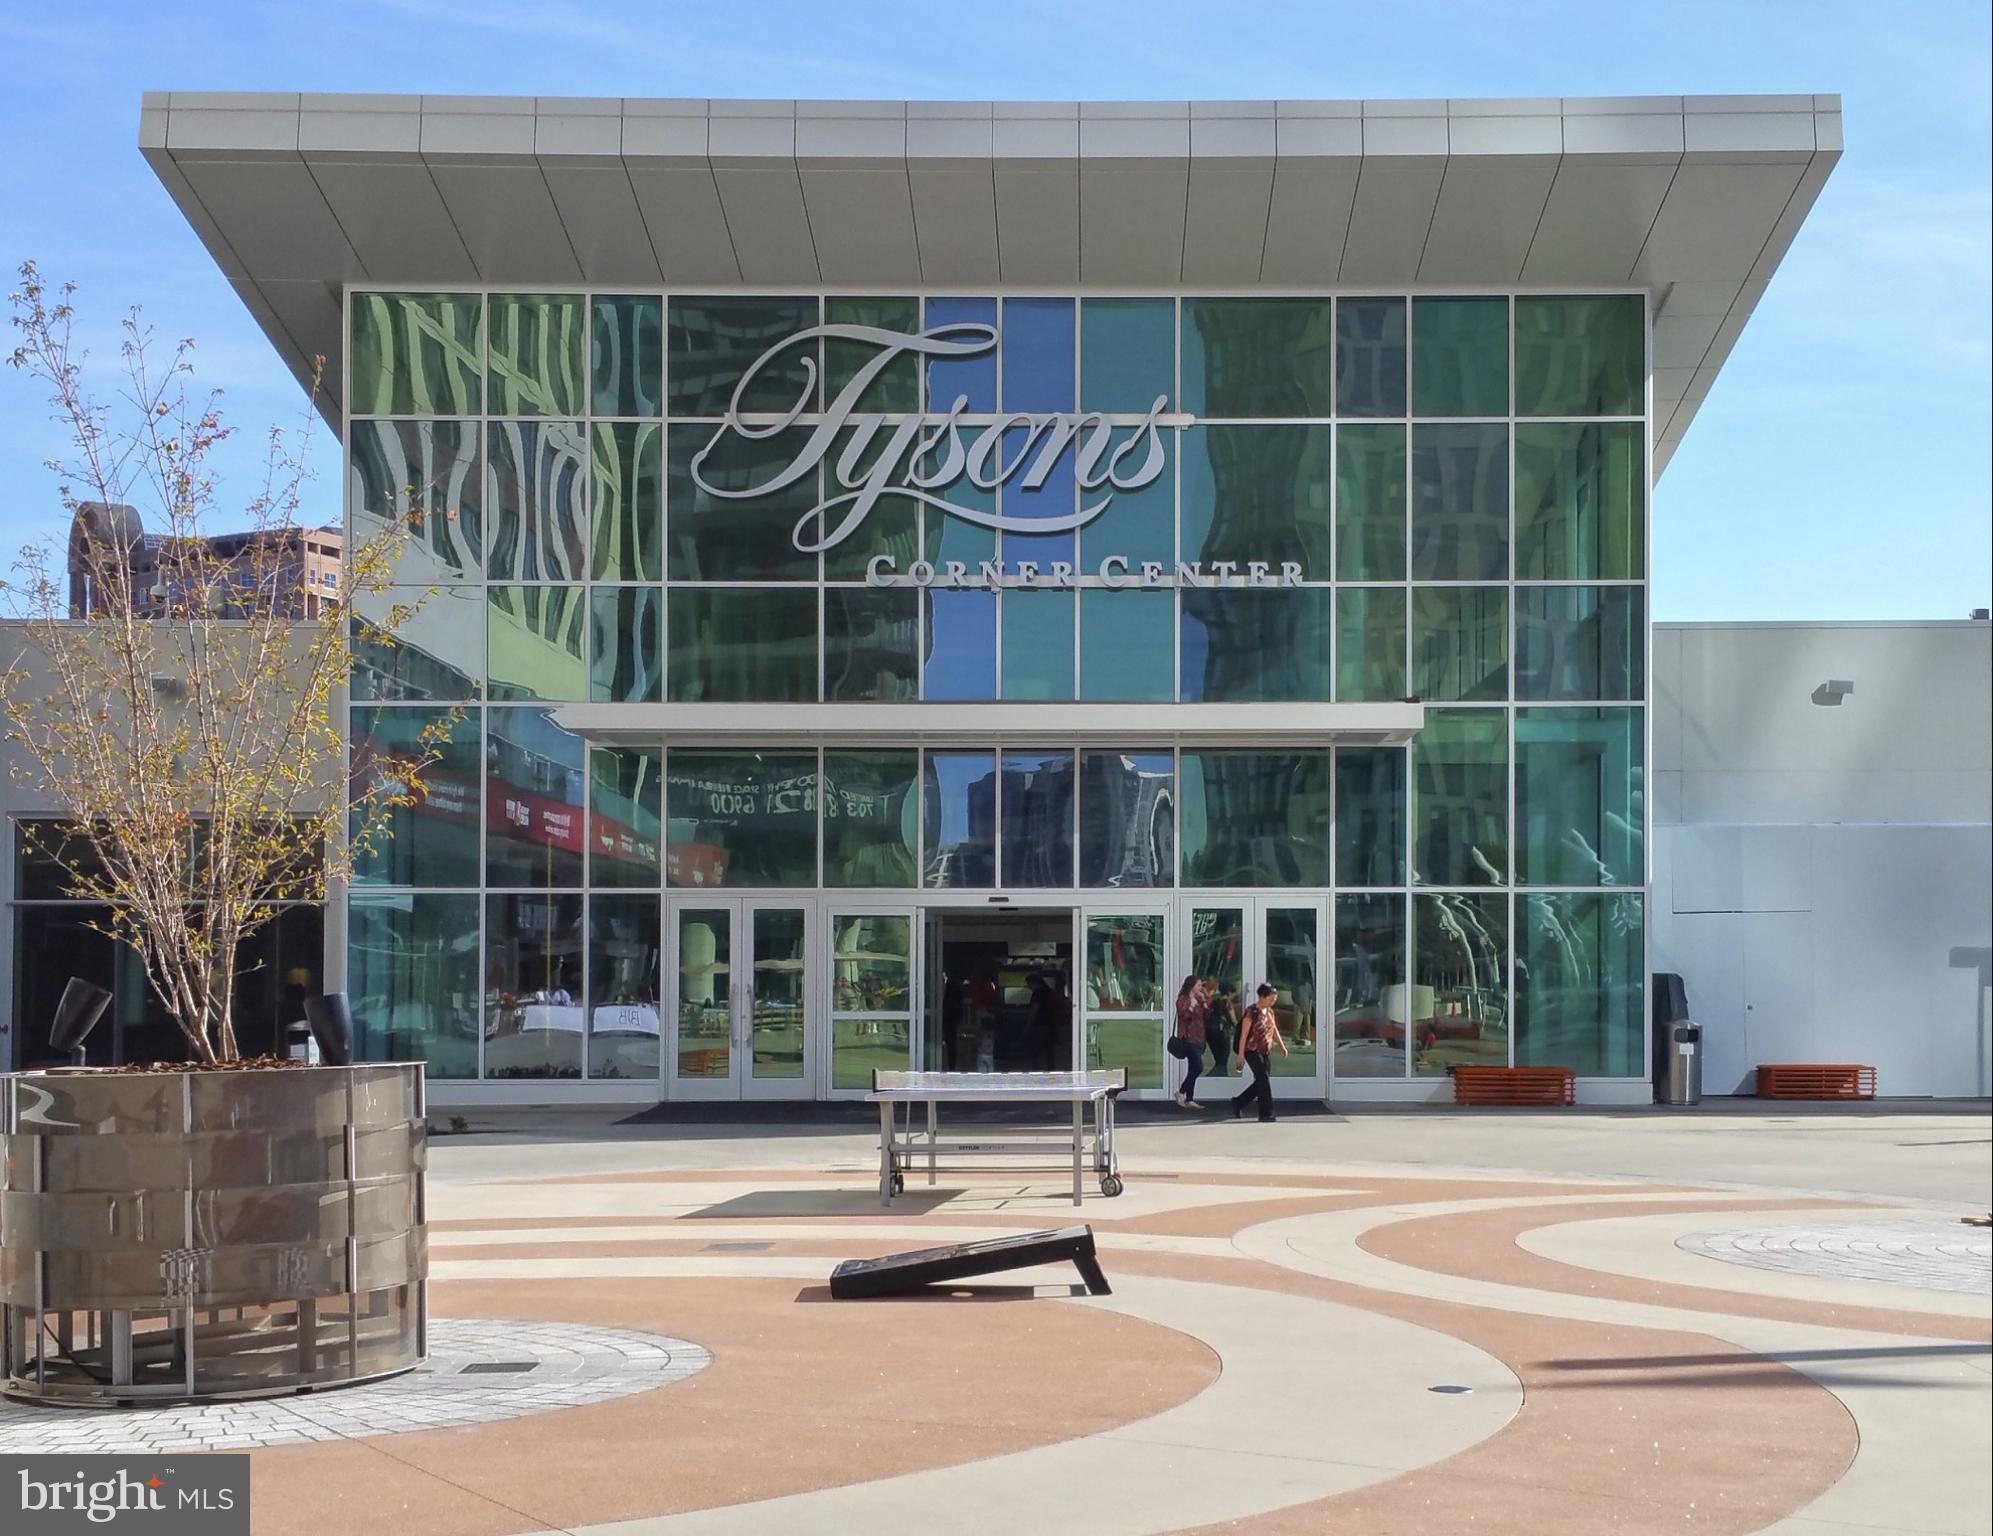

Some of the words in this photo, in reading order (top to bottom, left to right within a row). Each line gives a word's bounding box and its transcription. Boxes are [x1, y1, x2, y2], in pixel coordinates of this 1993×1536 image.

[691, 323, 1167, 552] Tysons
[867, 555, 1074, 588] CORNER
[1100, 555, 1304, 588] CENTER
